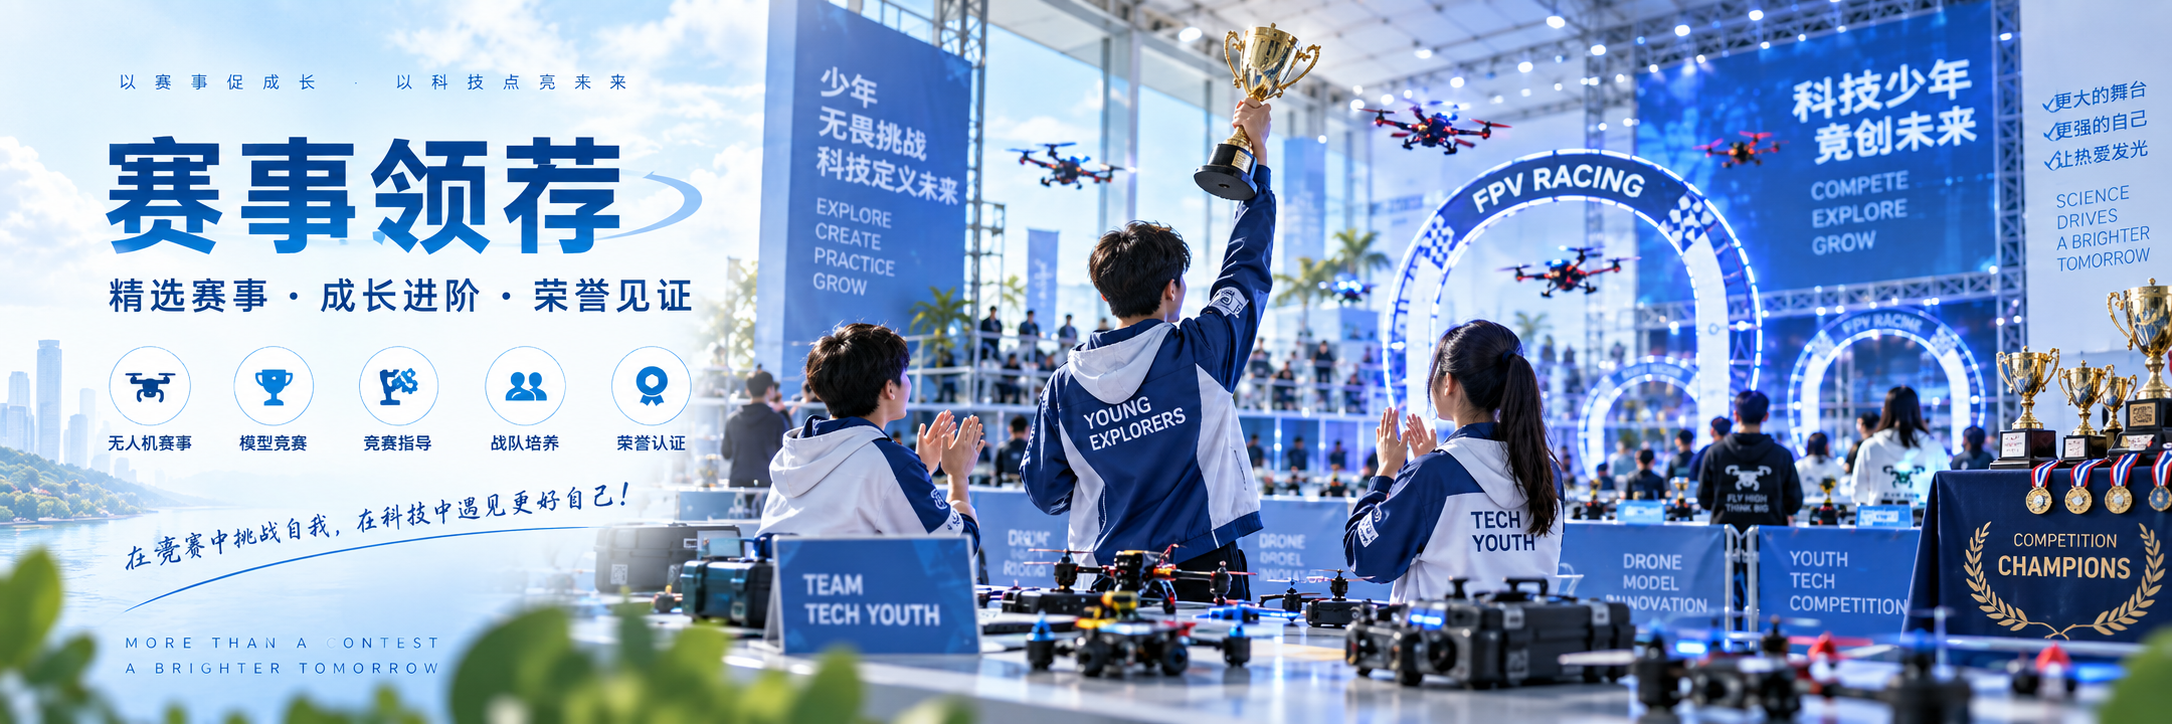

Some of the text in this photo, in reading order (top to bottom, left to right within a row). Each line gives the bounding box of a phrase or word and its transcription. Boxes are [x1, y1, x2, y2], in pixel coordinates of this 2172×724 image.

[819, 66, 878, 109] 少年
[1791, 58, 1973, 124] 科技少年
[2054, 80, 2147, 111] 更大的舞台
[818, 105, 927, 162] 无畏挑战
[1814, 105, 1978, 165] 竞创未来
[2055, 109, 2148, 140] 更强的自己
[2055, 139, 2149, 169] 让热爱发光
[816, 146, 959, 206] 科技定义未来
[1472, 164, 1646, 213] FPV RACING
[1810, 170, 1910, 201] COMPETE
[2056, 185, 2130, 209] SCIENCE
[816, 198, 892, 229] EXPLORE
[1812, 198, 1908, 229] EXPLORE
[2057, 208, 2118, 230] DRIVES
[815, 222, 882, 251] CREATE
[1812, 230, 1877, 256] GROW
[2056, 226, 2150, 251] A BRIGHTER
[814, 246, 895, 277] PRACTICE
[2057, 247, 2151, 272] TOMORROW
[813, 272, 868, 297] GROW
[1083, 396, 1152, 430] YOUNG
[1089, 407, 1186, 451] EXPLORERS
[1470, 511, 1521, 529] TECH
[1472, 534, 1535, 552] YOUTH
[2013, 532, 2118, 549] COMPETITION
[1623, 553, 1683, 570] DRONE
[1790, 550, 1849, 568] YOUTH
[1998, 554, 2131, 580] CHAMPIONS
[803, 573, 863, 597] TEAM
[1623, 575, 1680, 591] MODEL
[1790, 572, 1835, 589] TECH
[805, 603, 941, 626] TECH YOUTH
[1790, 595, 1907, 615] COMPETITION
